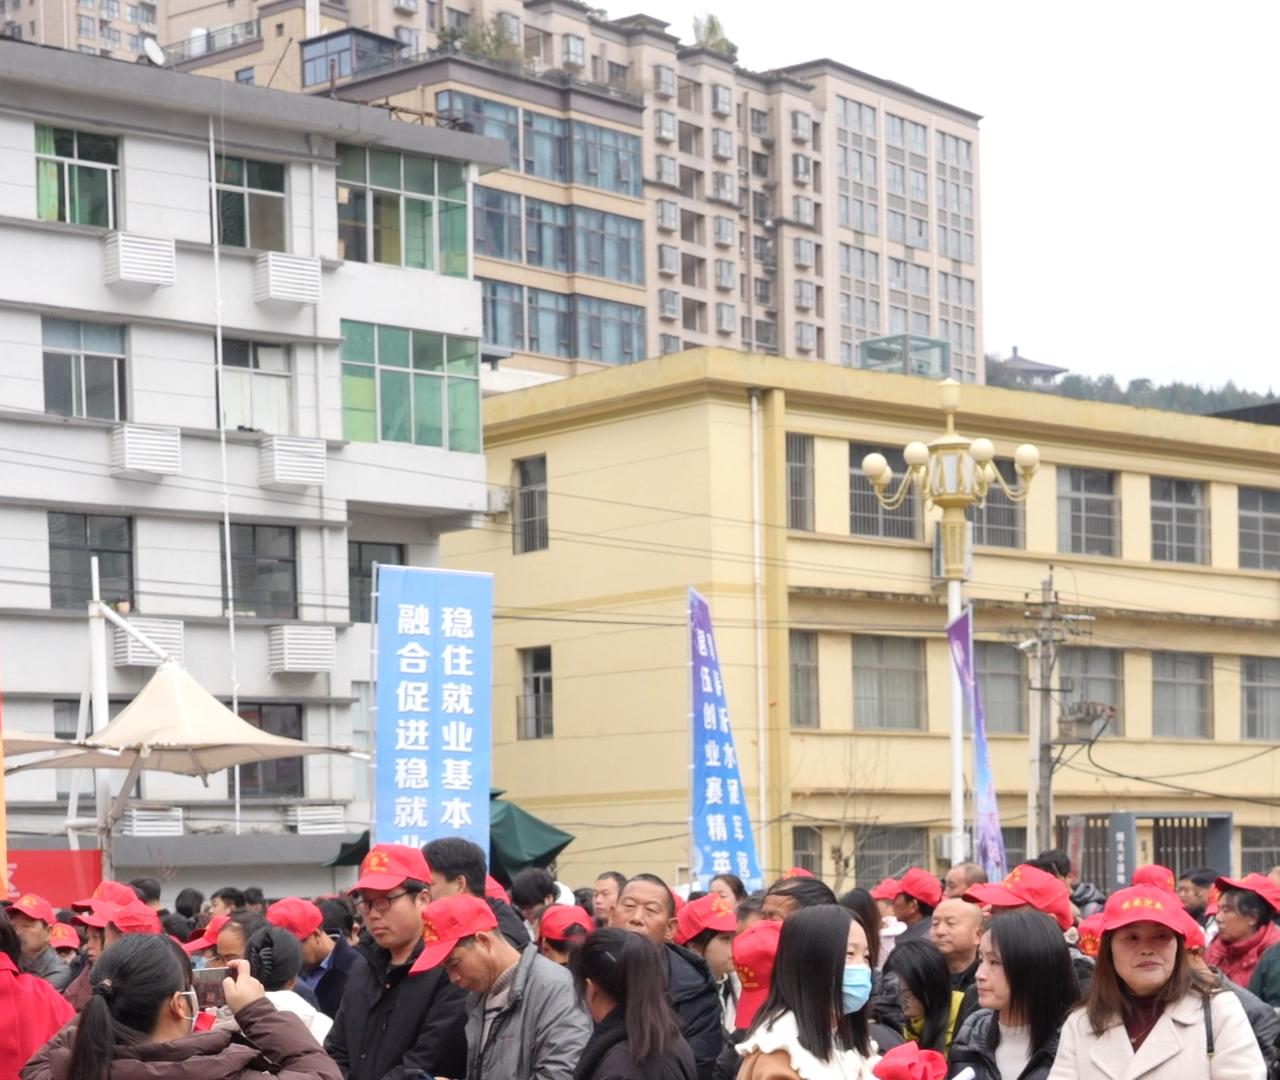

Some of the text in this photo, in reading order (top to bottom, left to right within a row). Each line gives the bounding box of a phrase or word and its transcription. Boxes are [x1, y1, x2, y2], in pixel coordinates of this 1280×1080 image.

[440, 606, 475, 830] 稳住就业基本
